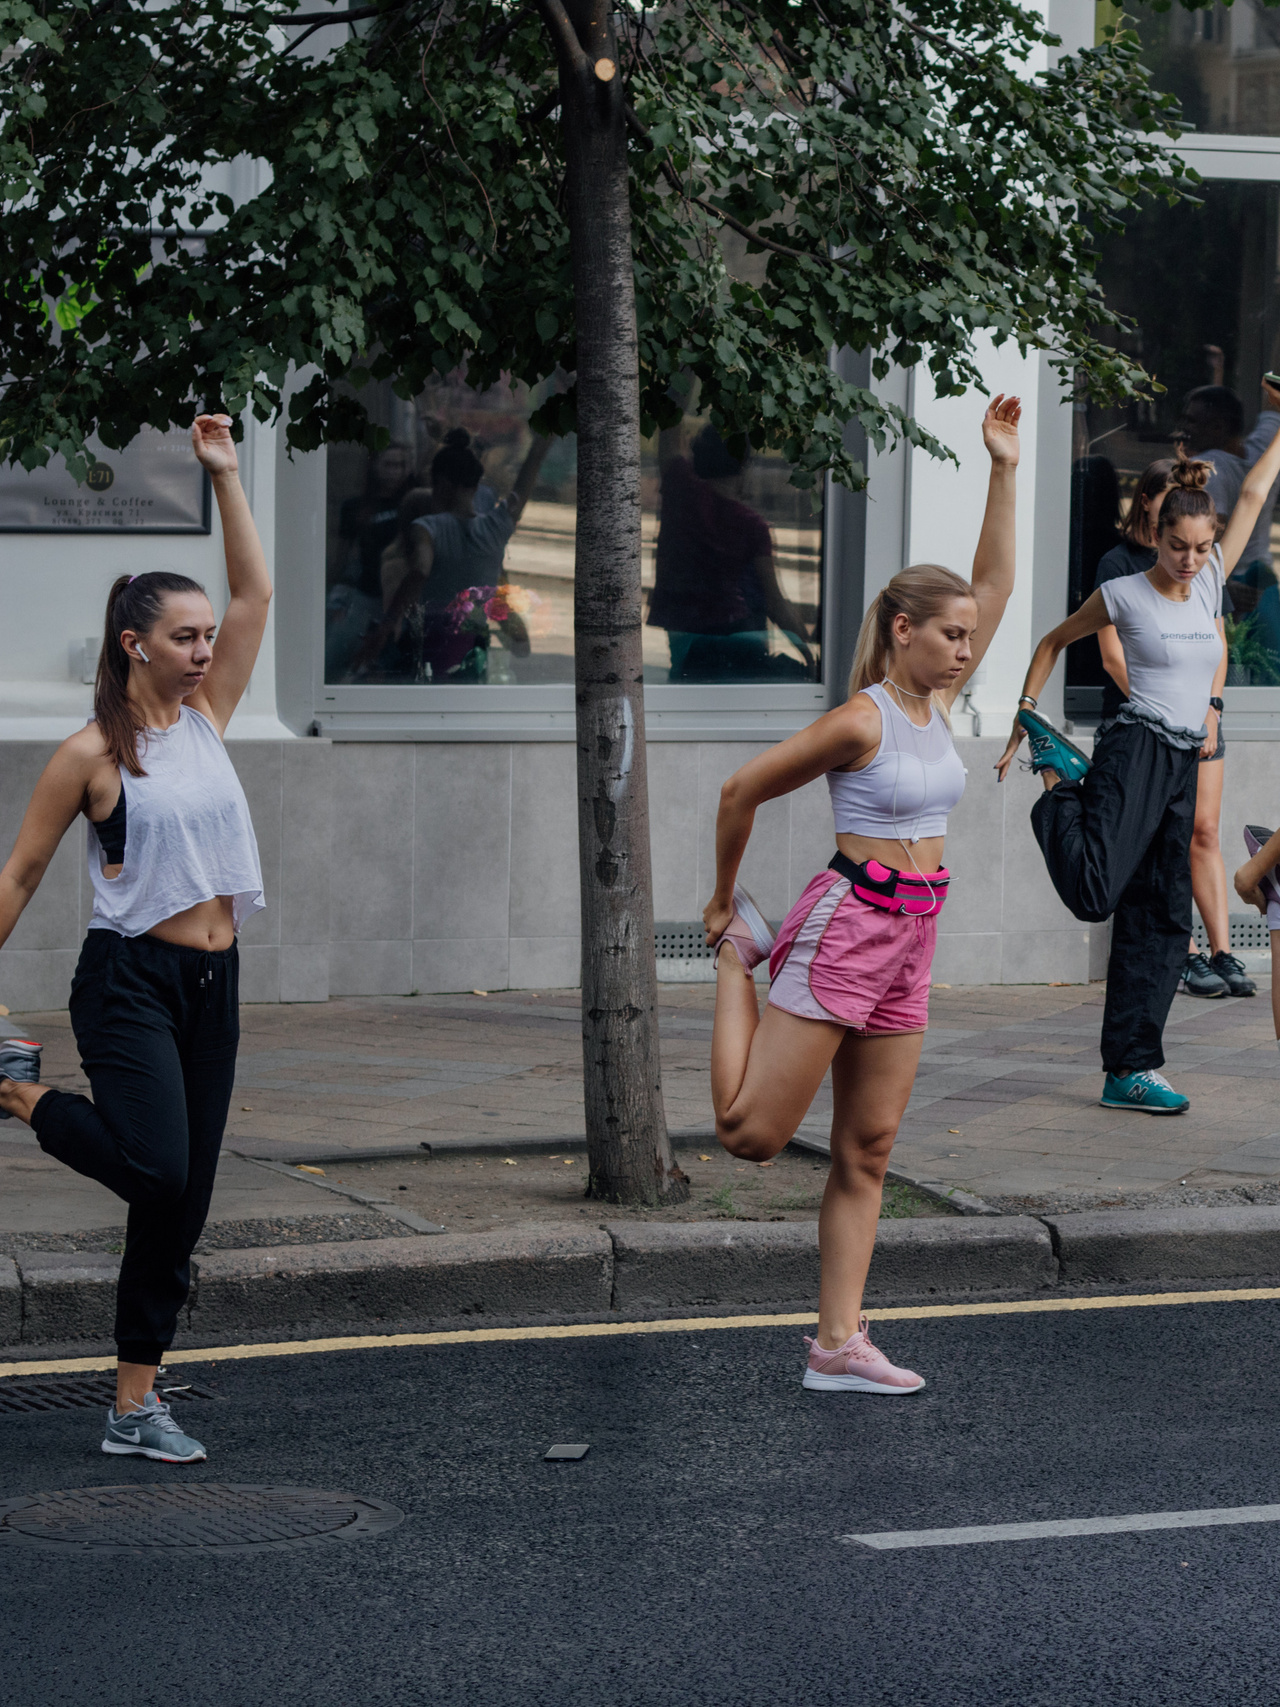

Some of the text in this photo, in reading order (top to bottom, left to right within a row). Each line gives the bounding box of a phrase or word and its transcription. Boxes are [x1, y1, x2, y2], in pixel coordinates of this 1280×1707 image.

[43, 496, 154, 508] Lounge & Coffee
[78, 508, 124, 518] Красная
[128, 508, 140, 517] 71
[1160, 632, 1215, 640] sensation
[1127, 1082, 1149, 1101] N
